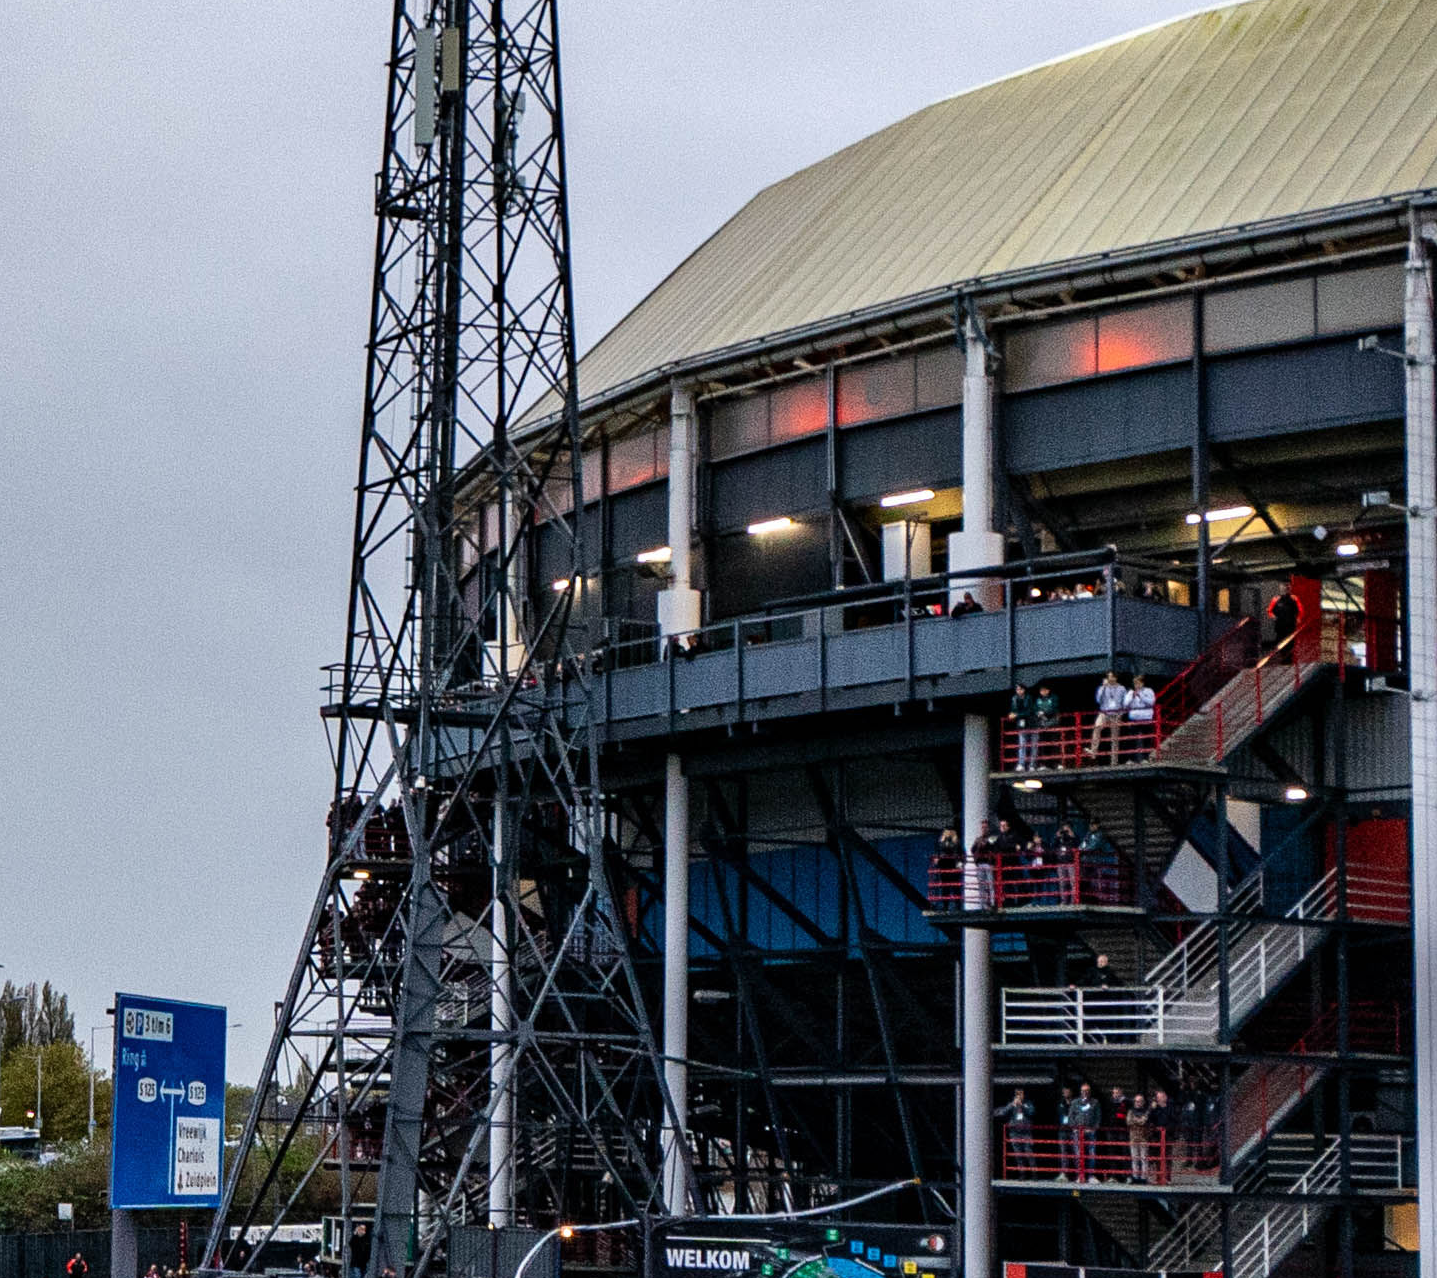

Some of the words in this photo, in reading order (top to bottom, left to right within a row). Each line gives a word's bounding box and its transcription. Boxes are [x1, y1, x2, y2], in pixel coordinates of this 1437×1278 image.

[145, 1014, 151, 1033] 3
[165, 1018, 171, 1035] 6
[121, 1047, 140, 1072] Ring
[178, 1123, 207, 1146] Vreewijk
[177, 1149, 205, 1164] Charlois
[185, 1171, 217, 1190] Zuidplein
[665, 1248, 750, 1271] WELKOM
